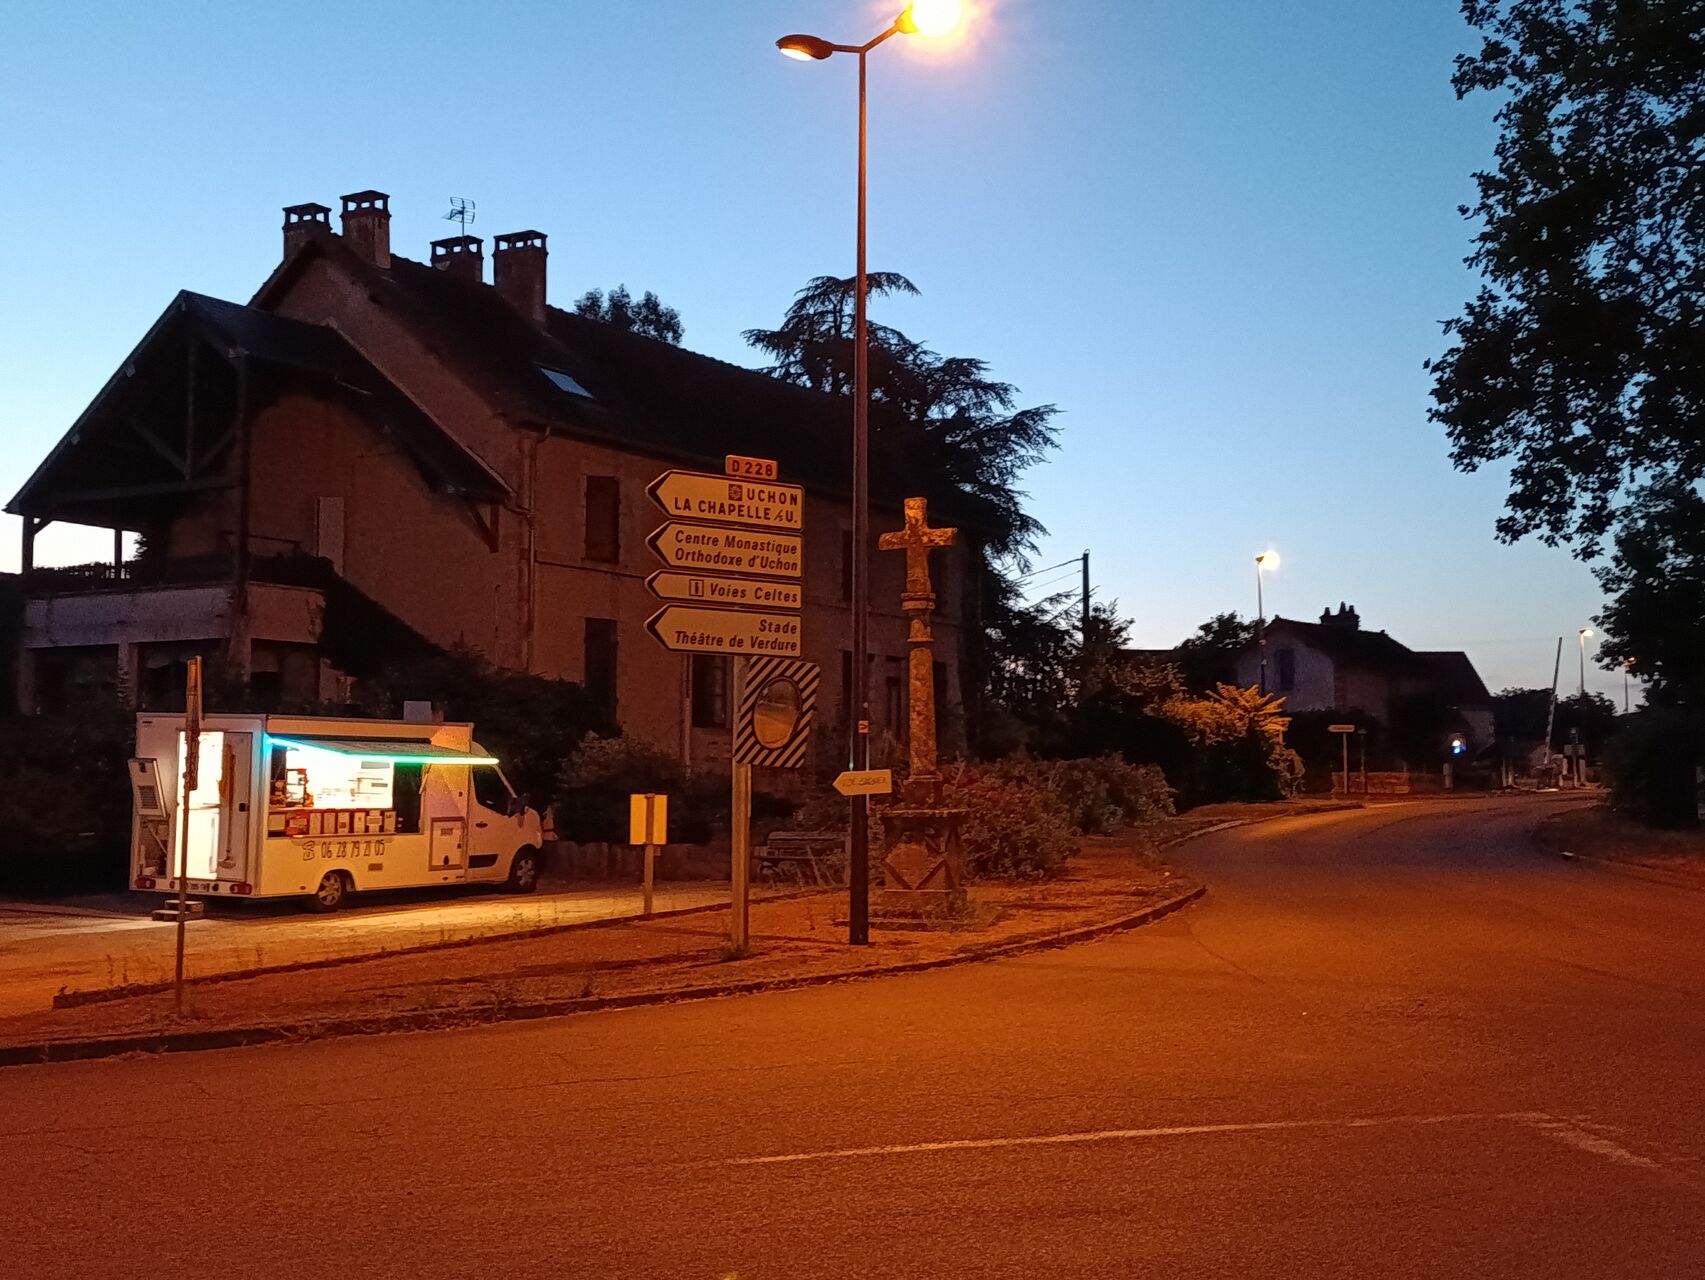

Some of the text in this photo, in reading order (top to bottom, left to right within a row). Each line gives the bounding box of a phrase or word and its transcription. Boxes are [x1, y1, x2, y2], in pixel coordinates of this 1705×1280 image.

[732, 460, 773, 476] D 228
[747, 487, 798, 506] UCHON
[674, 497, 692, 511] LA
[698, 499, 771, 520] CHAPELLE
[675, 530, 798, 556] Centre Monastique
[675, 547, 798, 572] Orthodoxe d'Uchon
[710, 583, 747, 598] Voies
[754, 587, 798, 603] Celtes
[759, 619, 798, 634] Stade
[675, 630, 798, 652] Théâtre de Verdure
[321, 841, 333, 858] 06
